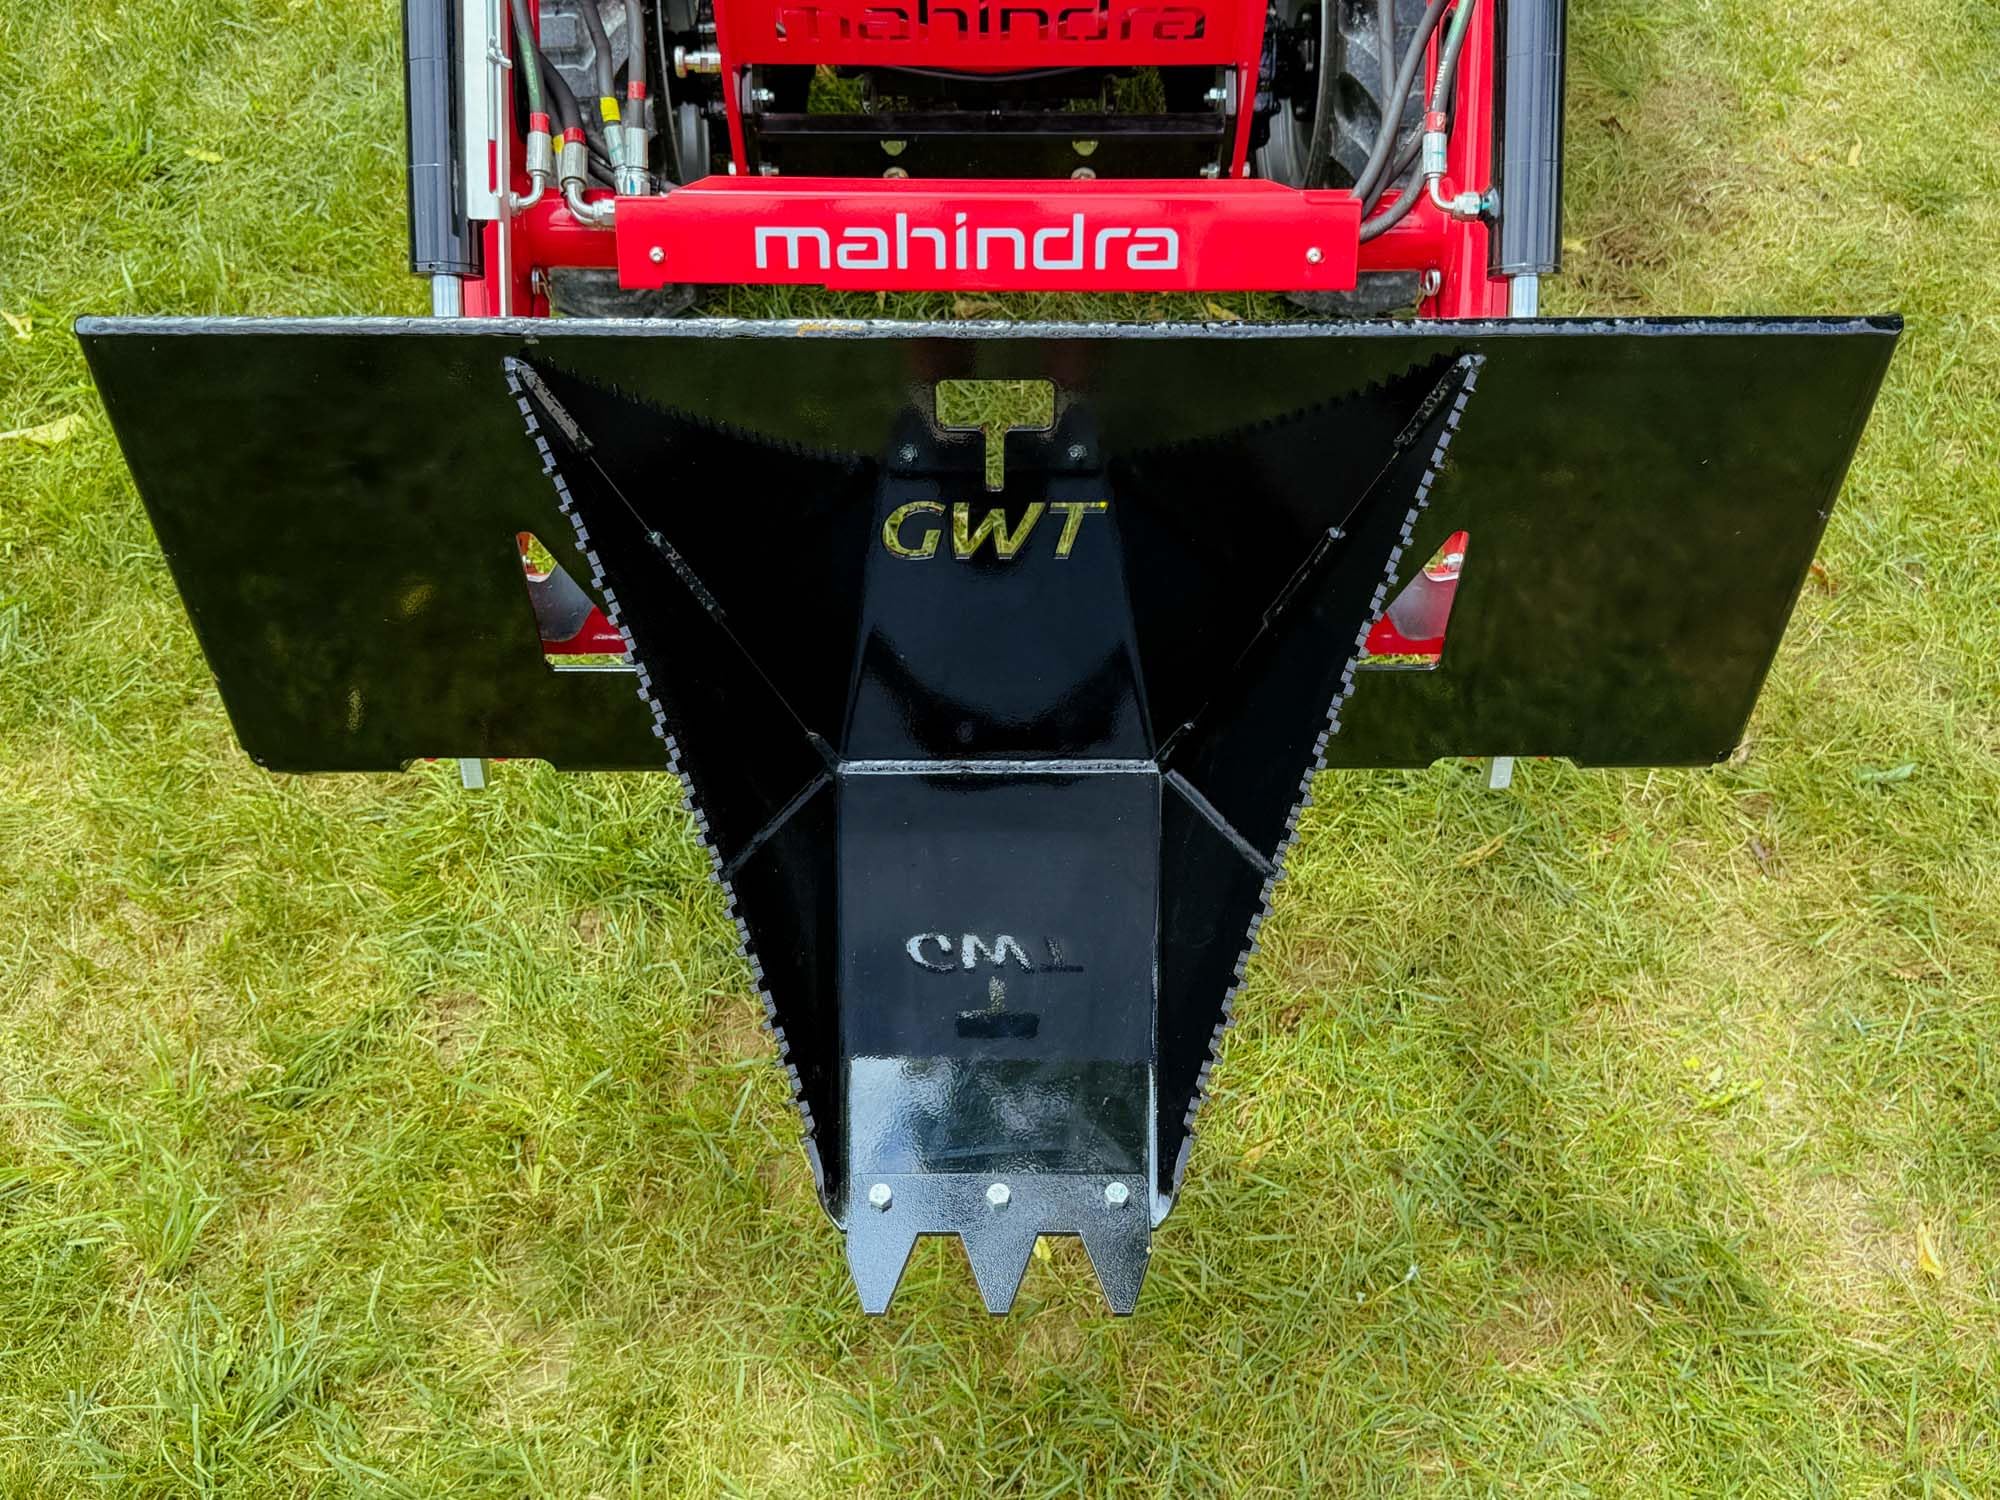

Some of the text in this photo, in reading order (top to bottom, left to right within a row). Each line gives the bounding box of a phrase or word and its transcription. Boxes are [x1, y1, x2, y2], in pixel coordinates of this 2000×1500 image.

[776, 0, 1206, 41] mahindra
[754, 213, 1179, 270] mahindra
[883, 501, 1109, 560] GWT
